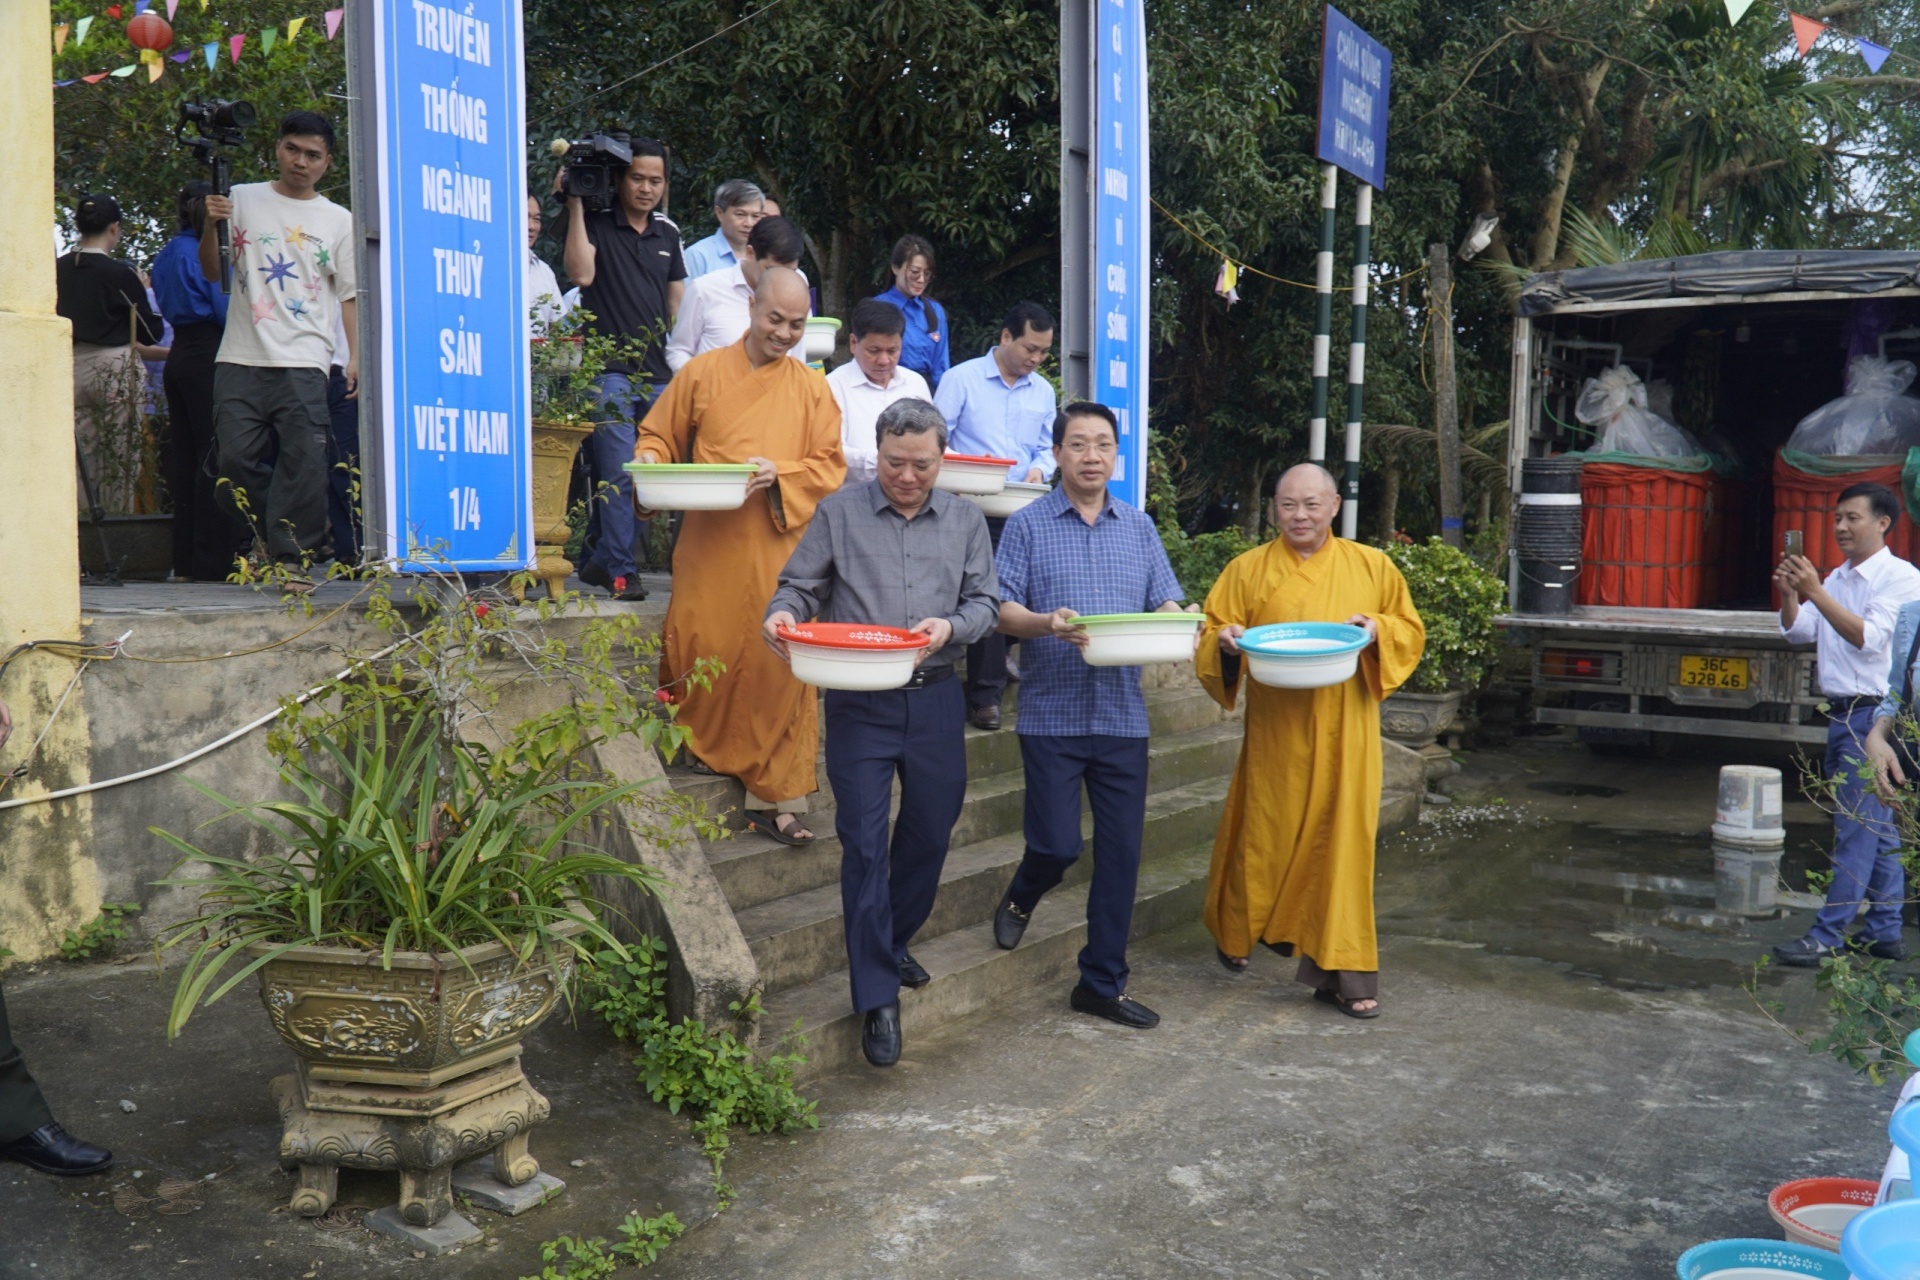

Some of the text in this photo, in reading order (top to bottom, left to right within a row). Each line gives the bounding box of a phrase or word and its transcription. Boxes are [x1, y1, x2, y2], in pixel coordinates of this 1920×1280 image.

[412, 0, 491, 67] TRUYỀN
[420, 76, 488, 144] THỐNG
[421, 161, 492, 223] NGÀNH
[433, 239, 484, 299] THUỶ
[439, 315, 482, 376] SẢN
[1107, 304, 1128, 342] SỐNG
[413, 397, 509, 461] VIỆT NAM
[449, 487, 480, 530] 1/4
[1687, 672, 1740, 687] 328.46
[1700, 658, 1728, 672] 36C
